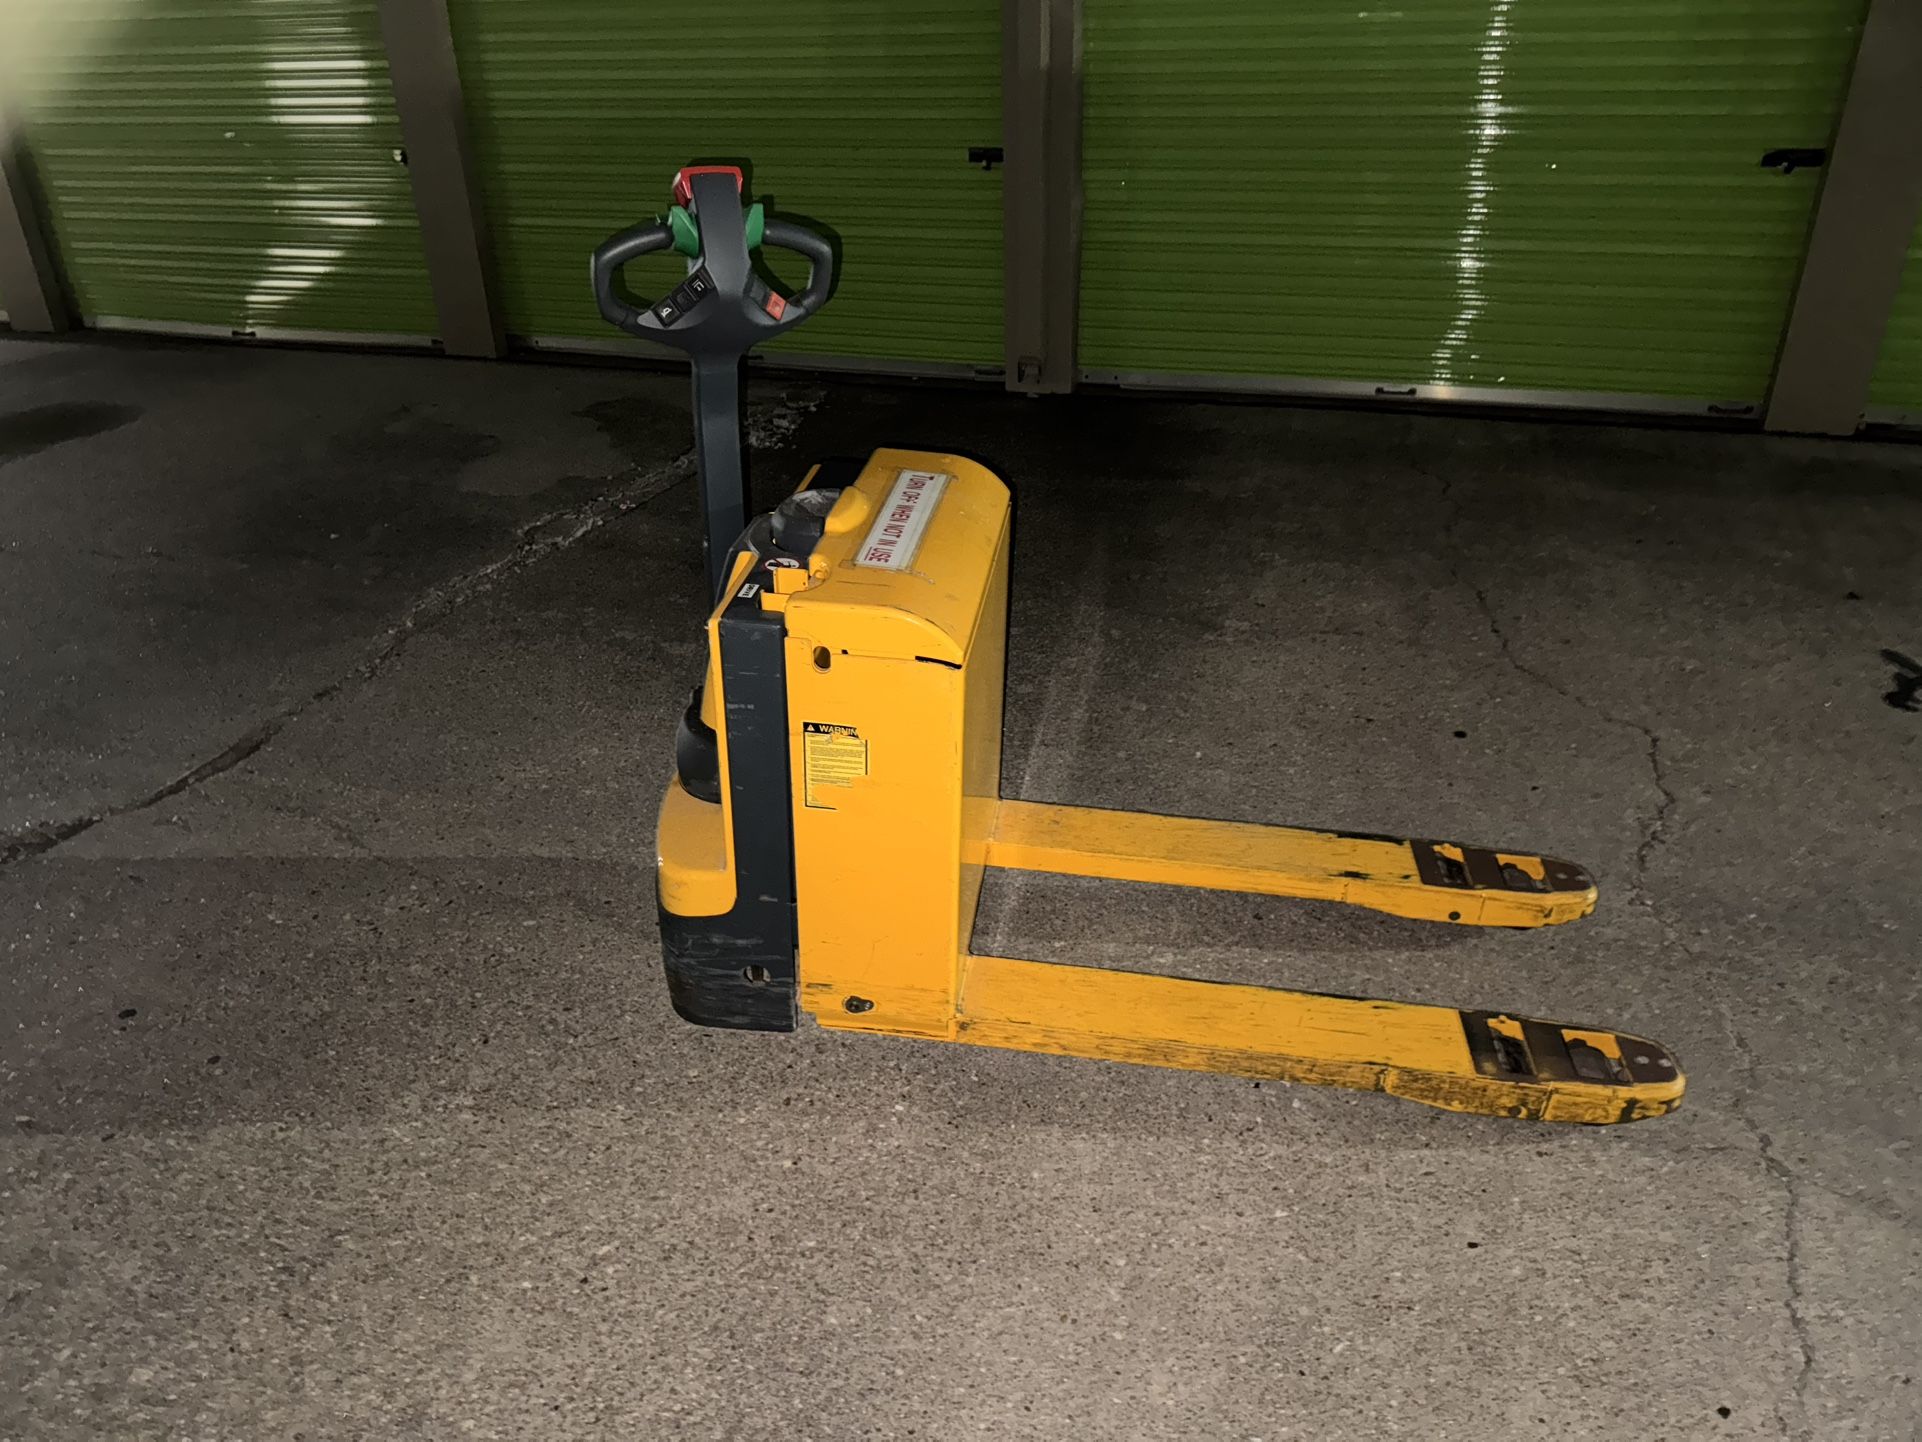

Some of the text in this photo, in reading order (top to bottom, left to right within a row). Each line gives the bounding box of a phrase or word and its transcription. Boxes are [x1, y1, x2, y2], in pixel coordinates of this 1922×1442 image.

[889, 504, 914, 523] WHEN
[882, 523, 905, 538] NOT
[868, 548, 893, 563] USE
[818, 724, 857, 736] WARNIN
